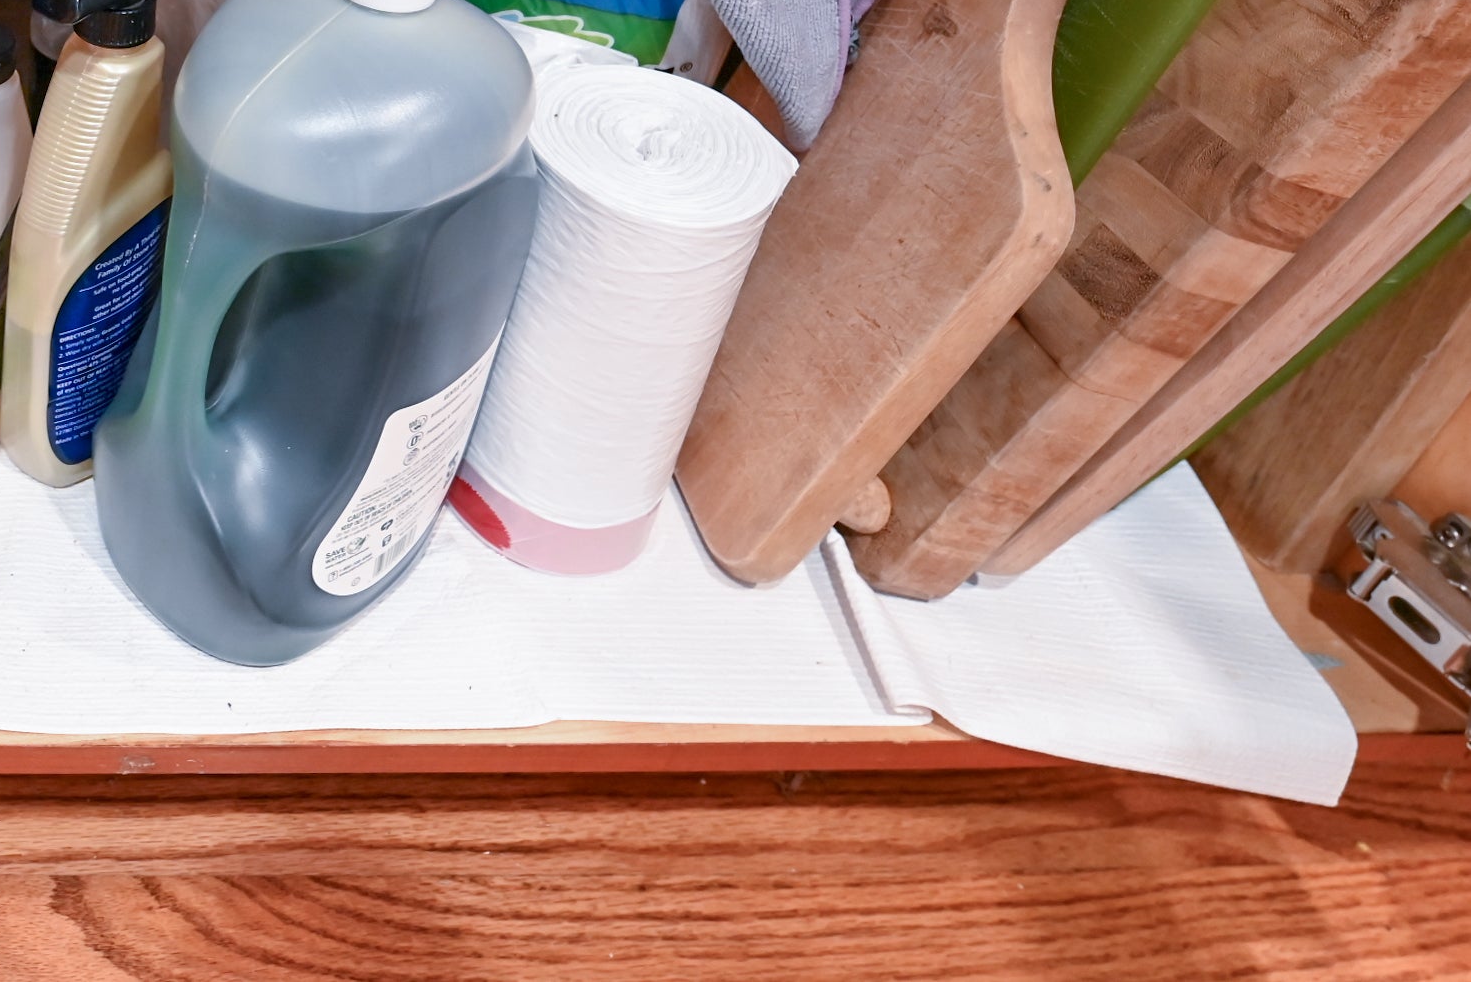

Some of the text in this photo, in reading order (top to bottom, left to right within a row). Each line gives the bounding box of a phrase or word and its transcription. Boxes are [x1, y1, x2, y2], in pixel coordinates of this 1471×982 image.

[94, 252, 124, 271] Created
[96, 263, 123, 279] Family
[59, 326, 97, 344] DIRECTIONS:
[324, 547, 346, 559] SAVE
